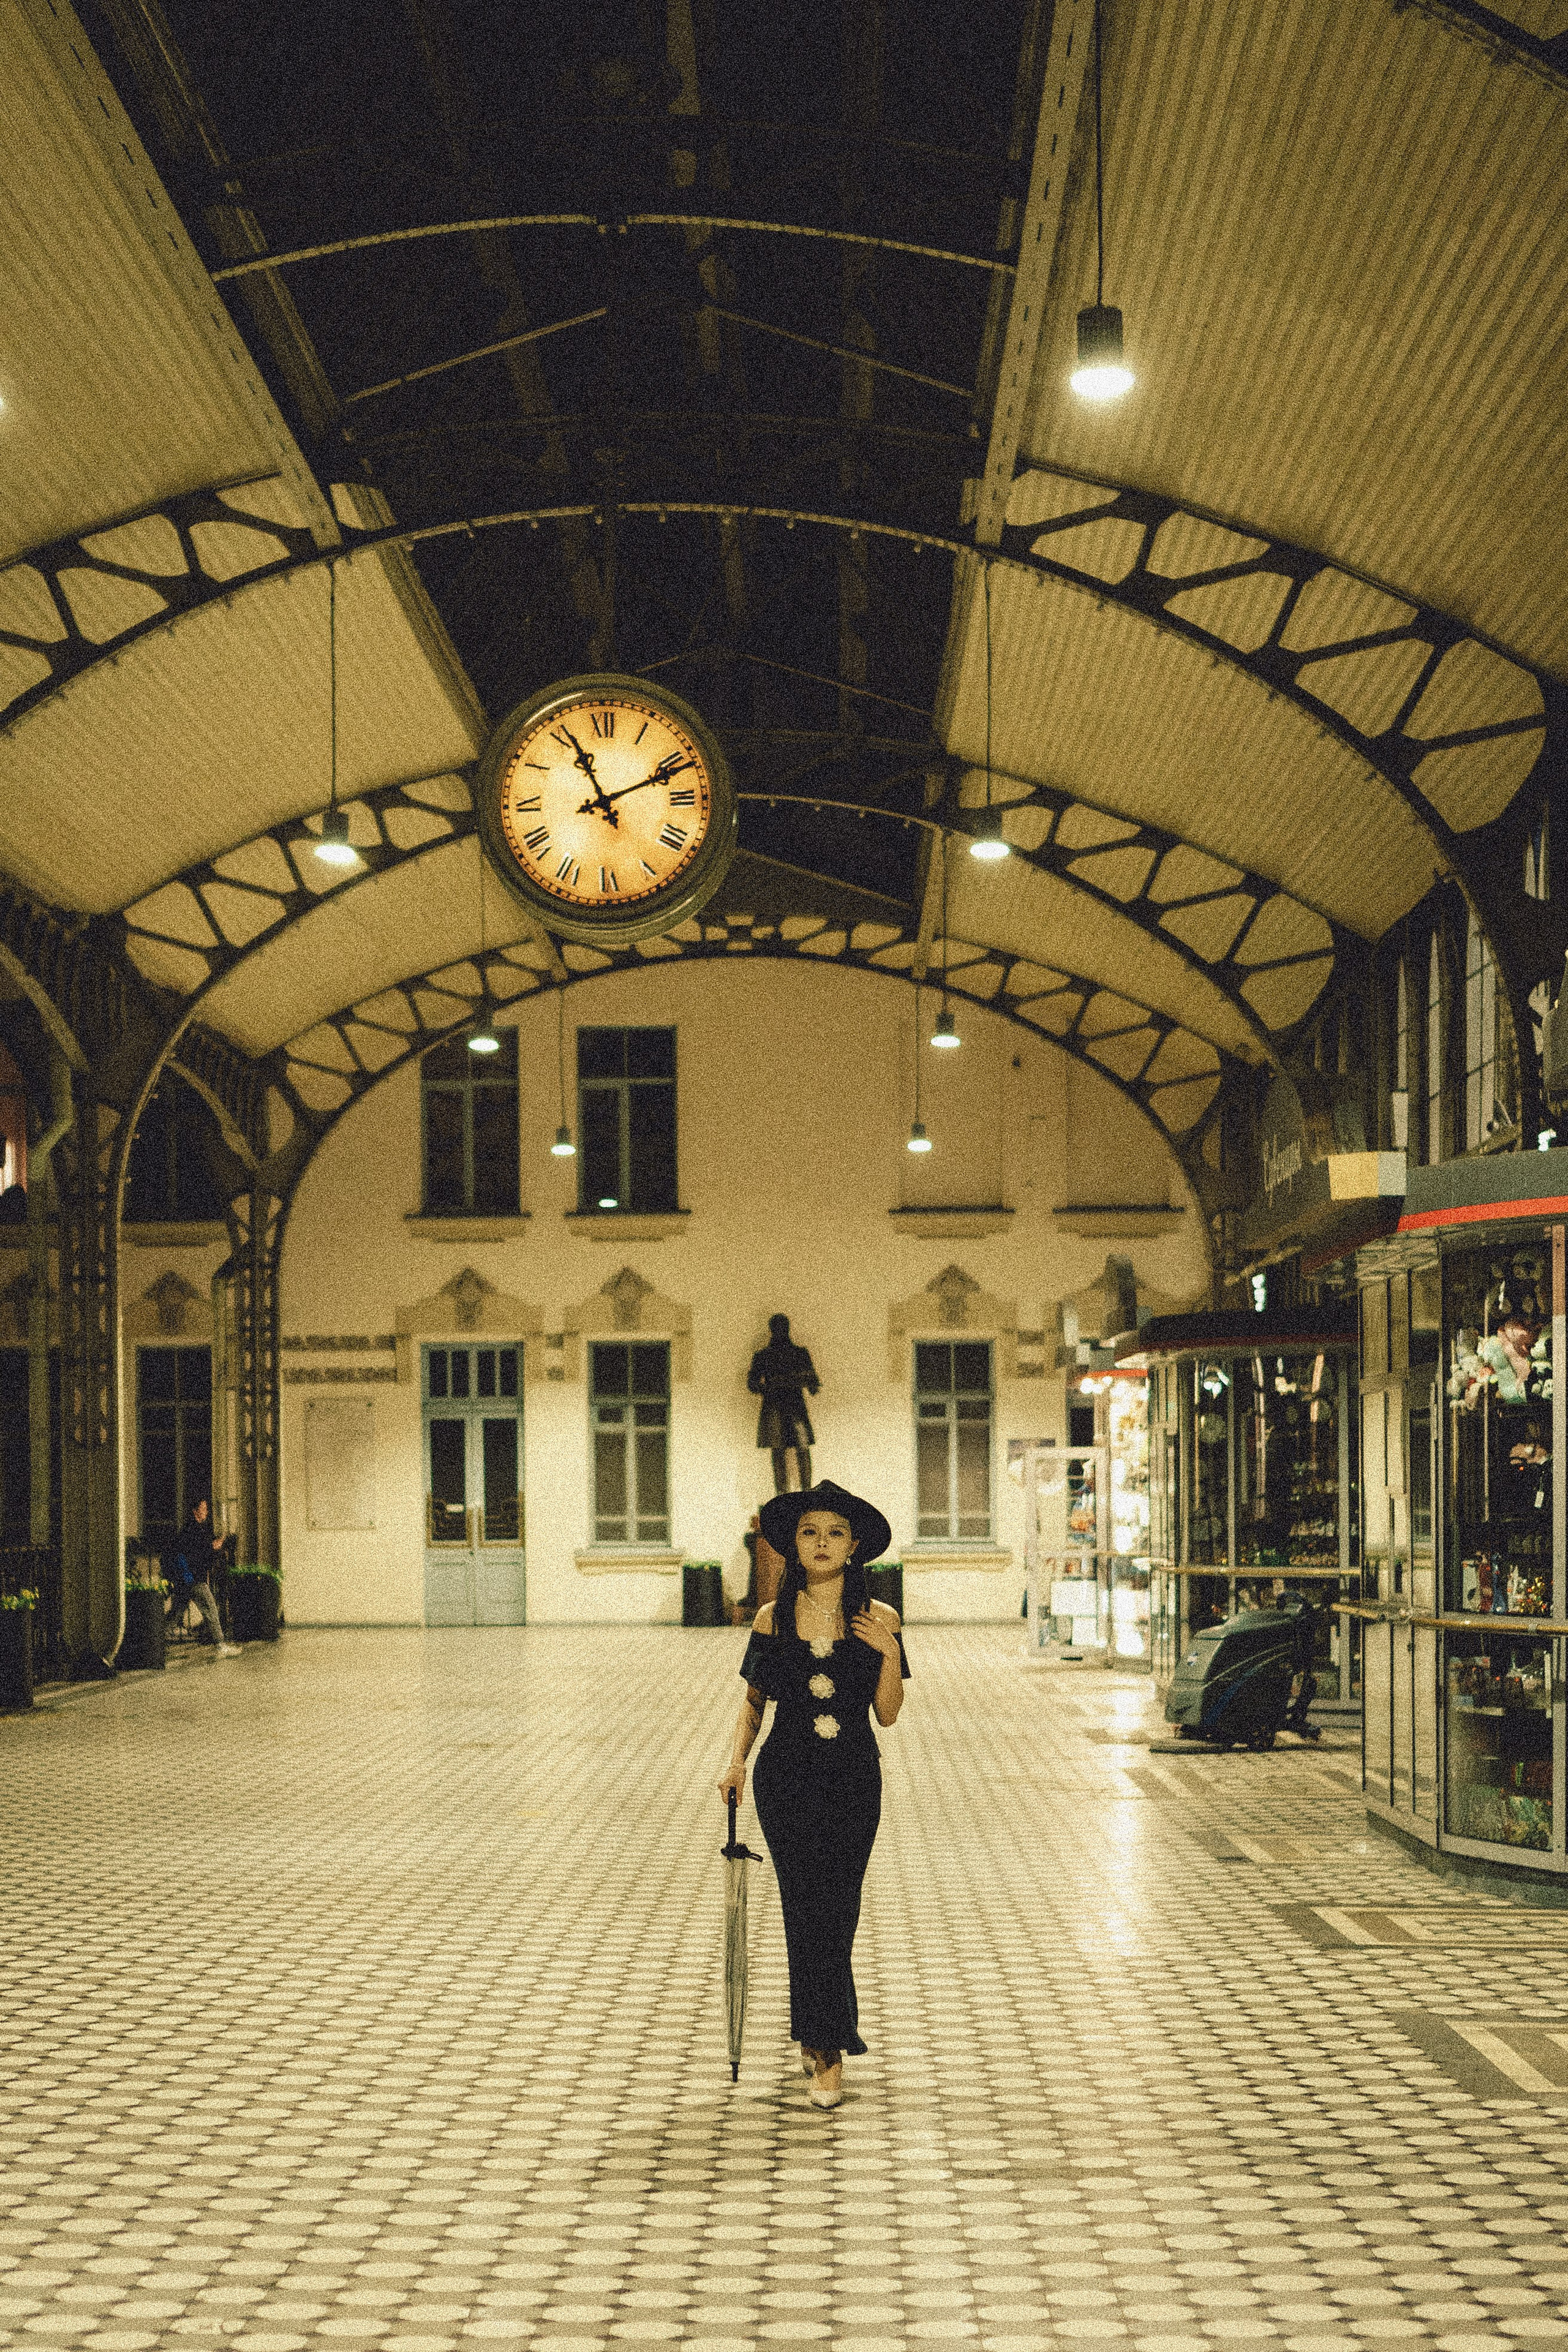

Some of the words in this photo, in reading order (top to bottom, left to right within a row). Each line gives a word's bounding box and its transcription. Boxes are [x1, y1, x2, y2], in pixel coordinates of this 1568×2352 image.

[590, 712, 614, 739] XII
[635, 722, 649, 745] I
[669, 790, 695, 807] III
